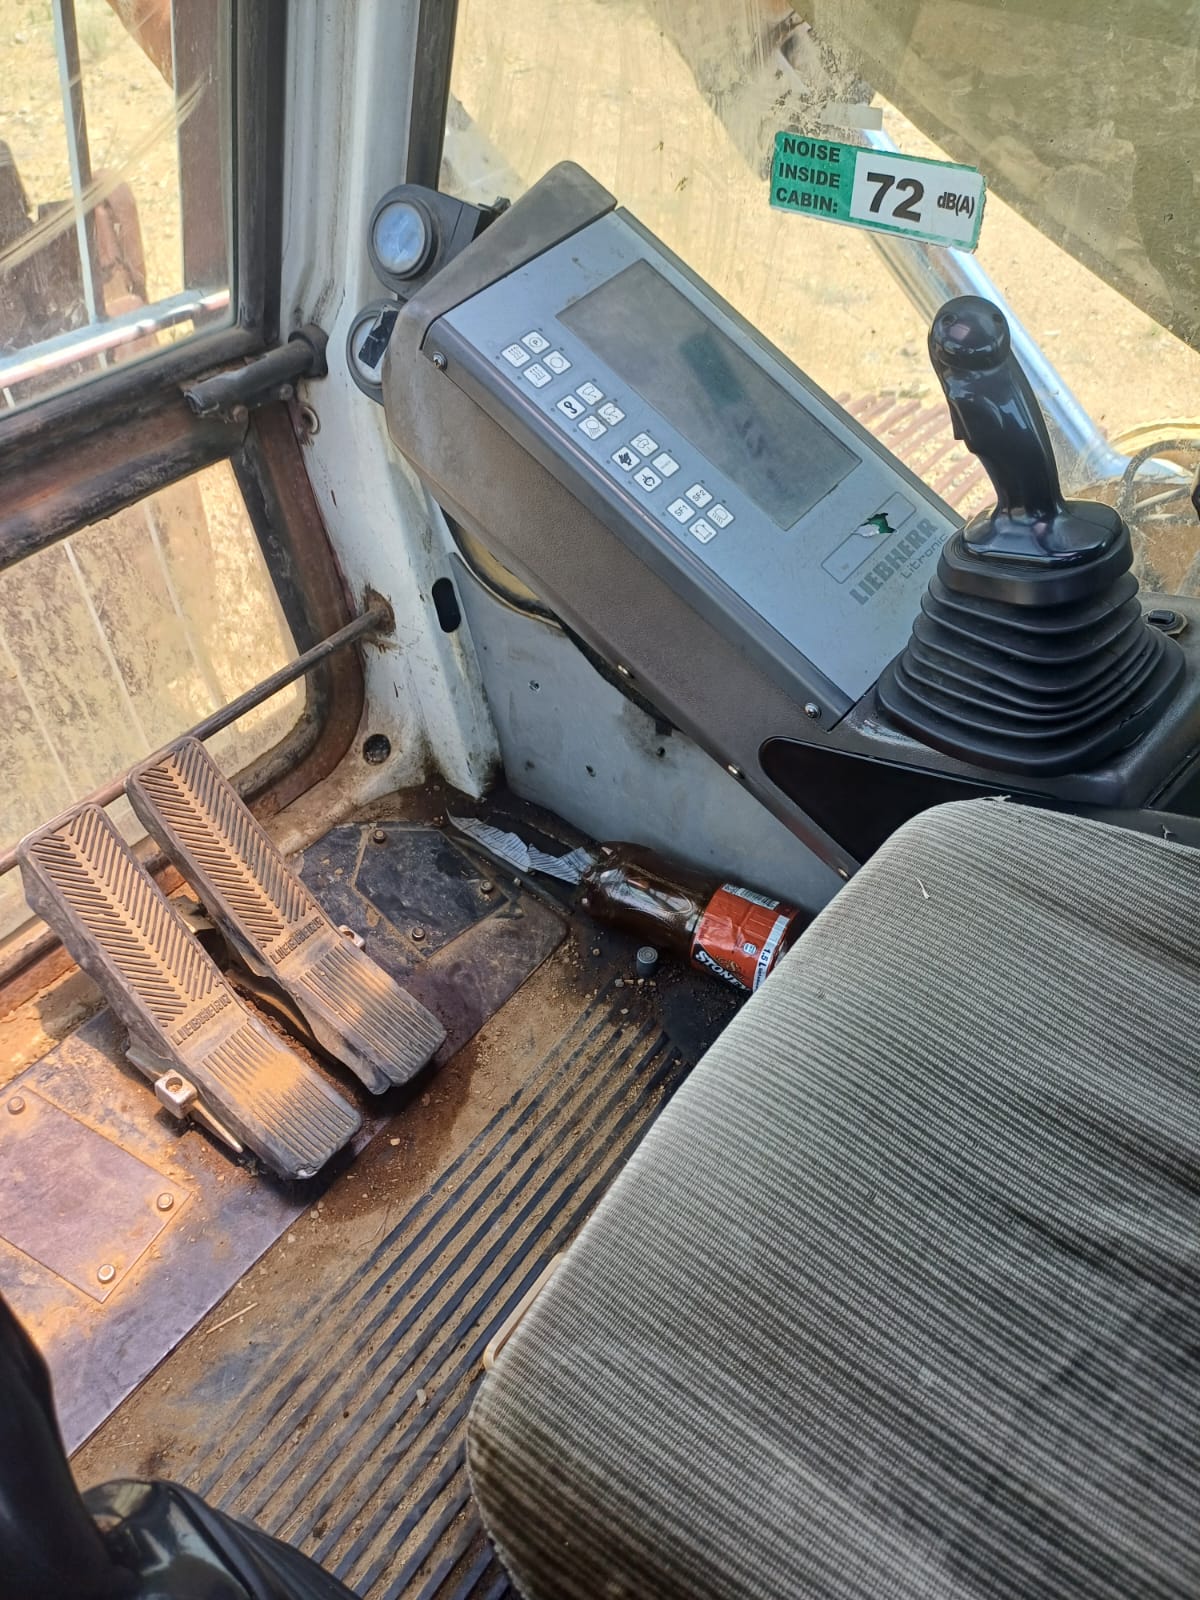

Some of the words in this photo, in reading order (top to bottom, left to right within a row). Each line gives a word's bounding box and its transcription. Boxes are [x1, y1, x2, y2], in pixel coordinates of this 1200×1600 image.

[783, 138, 841, 163] NOISE
[779, 162, 840, 189] INSIDE
[776, 187, 838, 213] CABIN:
[866, 172, 925, 223] 72
[937, 191, 975, 219] dB(A)
[674, 504, 688, 517] SF1
[849, 518, 938, 605] LIEBHERR
[269, 916, 325, 965] LIEBHERR
[170, 993, 232, 1046] LIEBHERR
